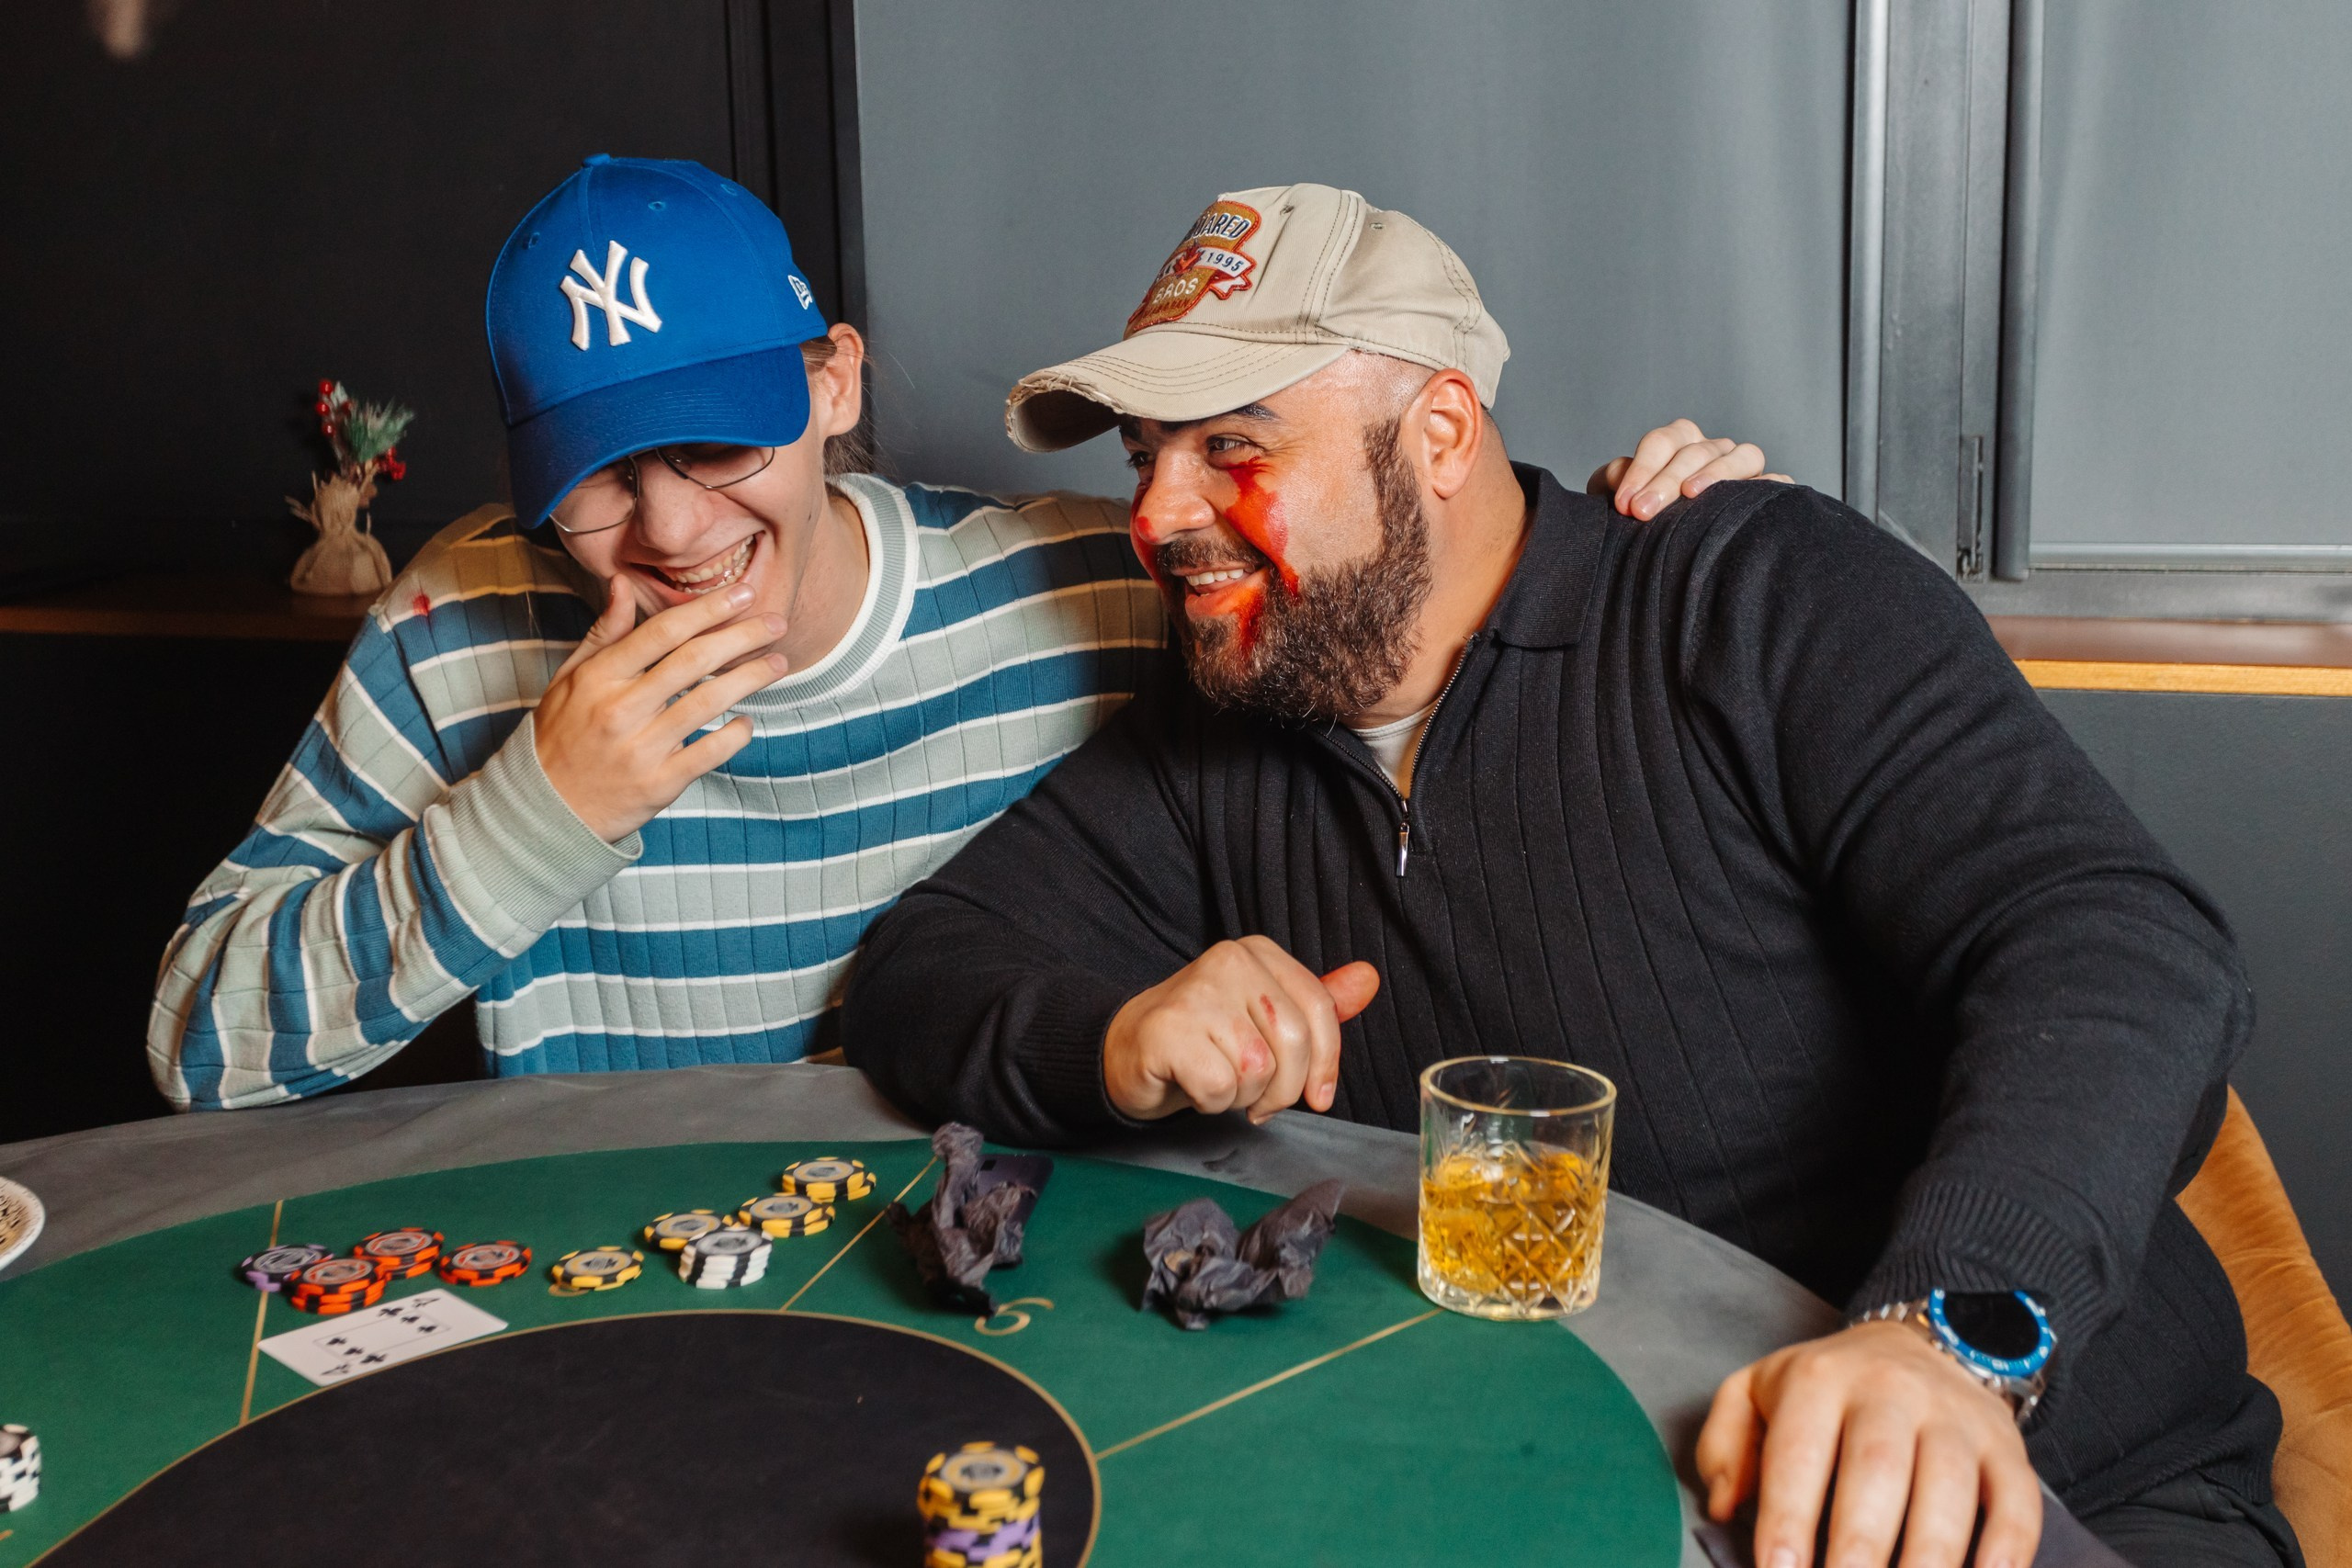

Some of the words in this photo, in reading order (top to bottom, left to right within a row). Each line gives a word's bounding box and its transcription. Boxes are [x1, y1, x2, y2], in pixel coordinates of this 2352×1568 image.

[1206, 252, 1245, 272] 1995
[560, 240, 662, 351] NY
[974, 1296, 1055, 1337] 6
